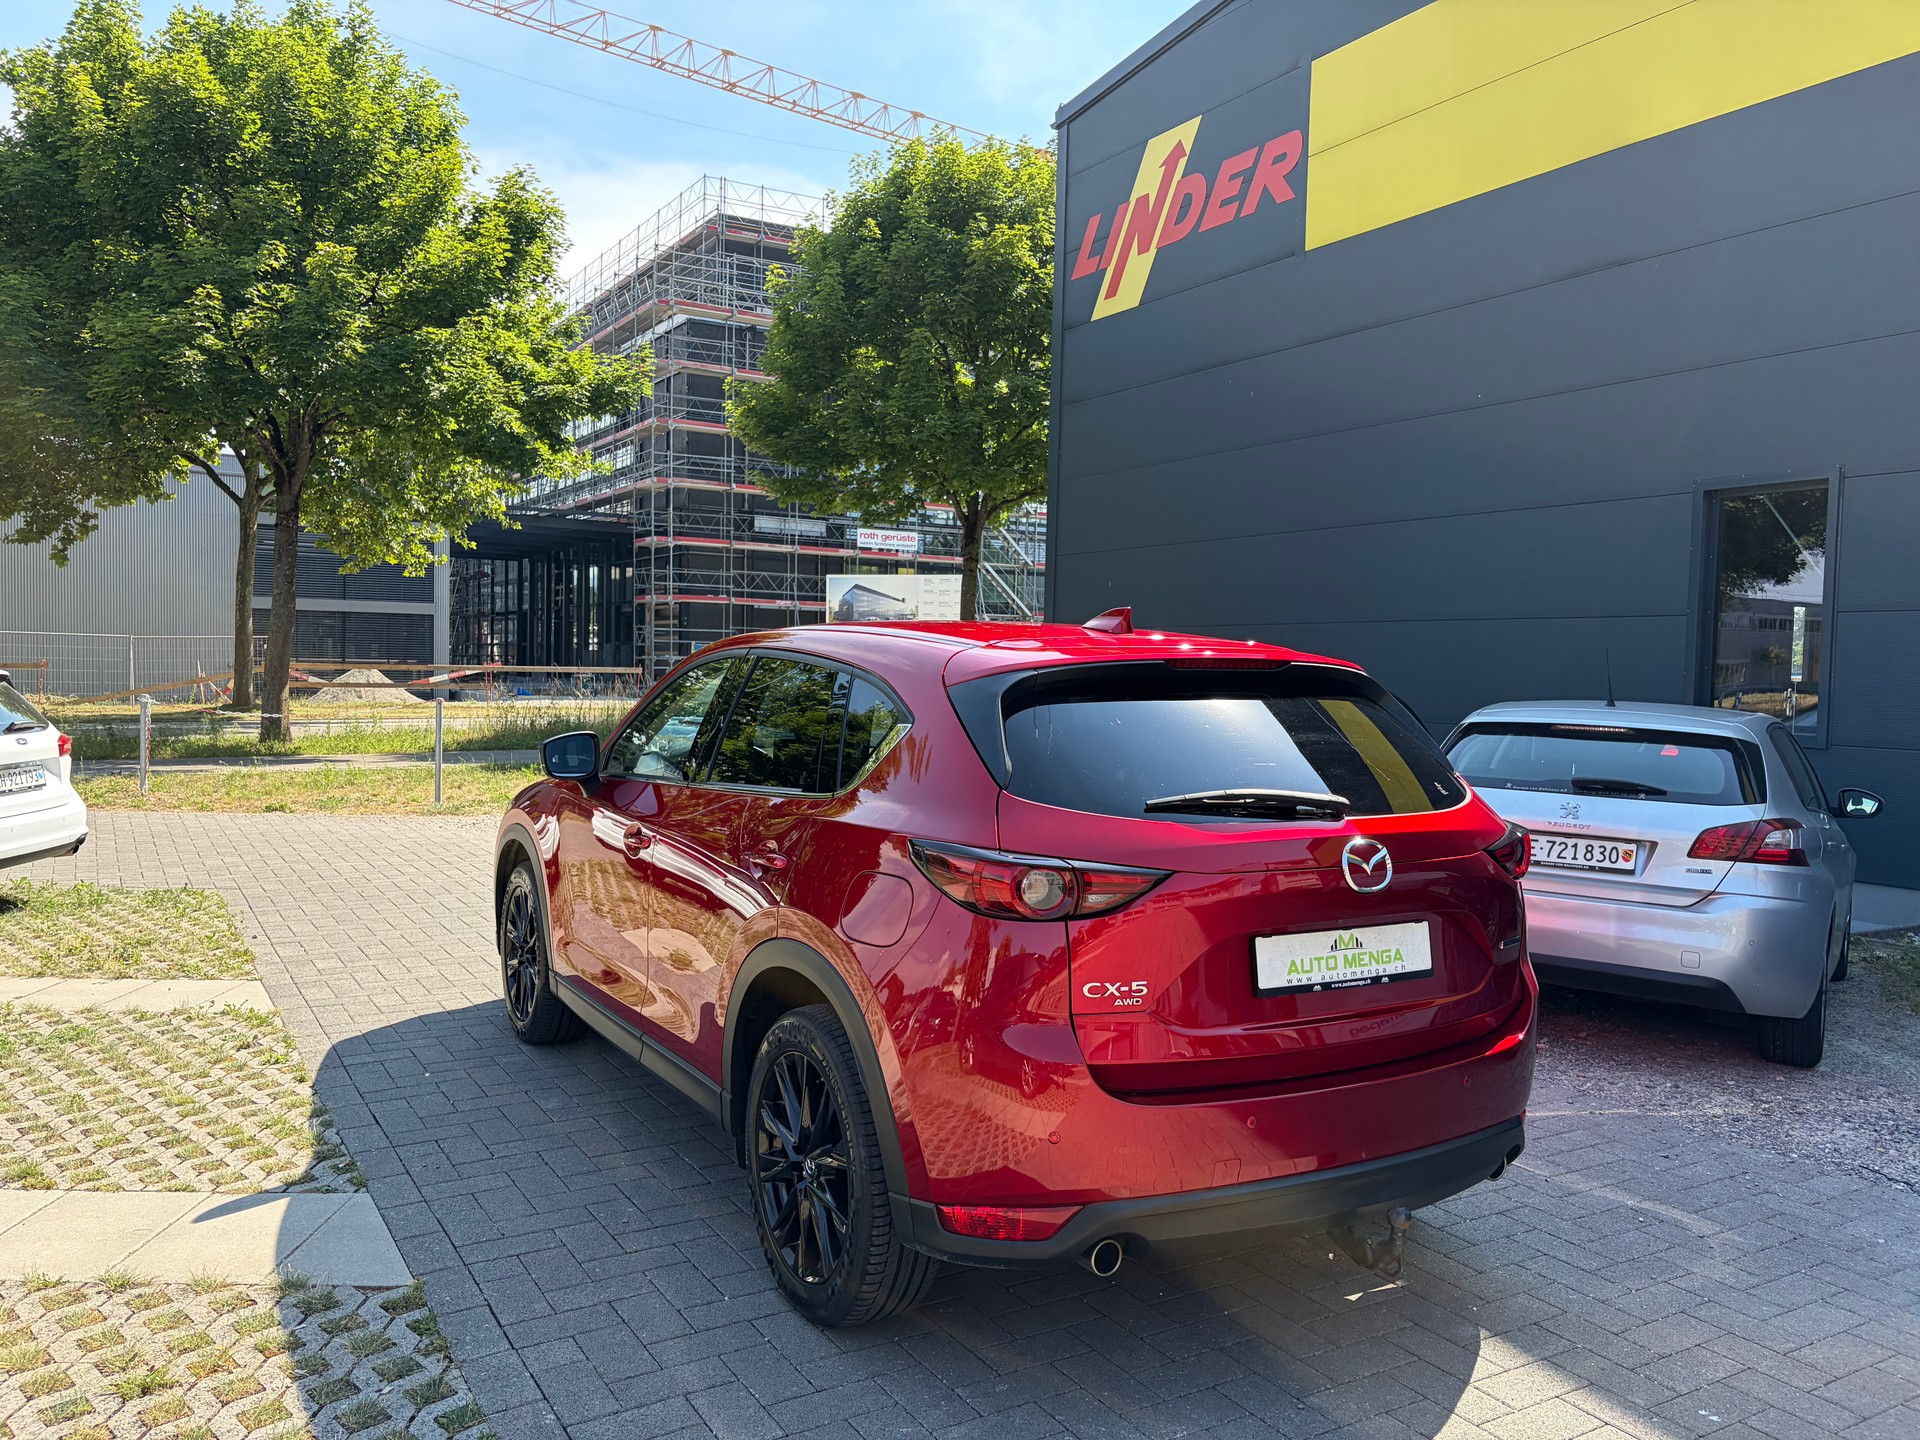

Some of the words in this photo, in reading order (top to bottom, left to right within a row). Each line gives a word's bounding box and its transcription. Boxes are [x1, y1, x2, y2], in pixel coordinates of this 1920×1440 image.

[1071, 129, 1304, 300] LINDER
[859, 532, 879, 540] roth
[881, 533, 916, 542] gerüste
[1545, 820, 1592, 830] PEUGEOT
[1287, 954, 1338, 976] AUTO
[1343, 947, 1405, 969] MENGA
[1287, 964, 1407, 985] www.automenga.ch
[1082, 980, 1149, 998] CX-5
[1331, 978, 1371, 988] www.automenga.ch
[1113, 998, 1142, 1006] AWD
